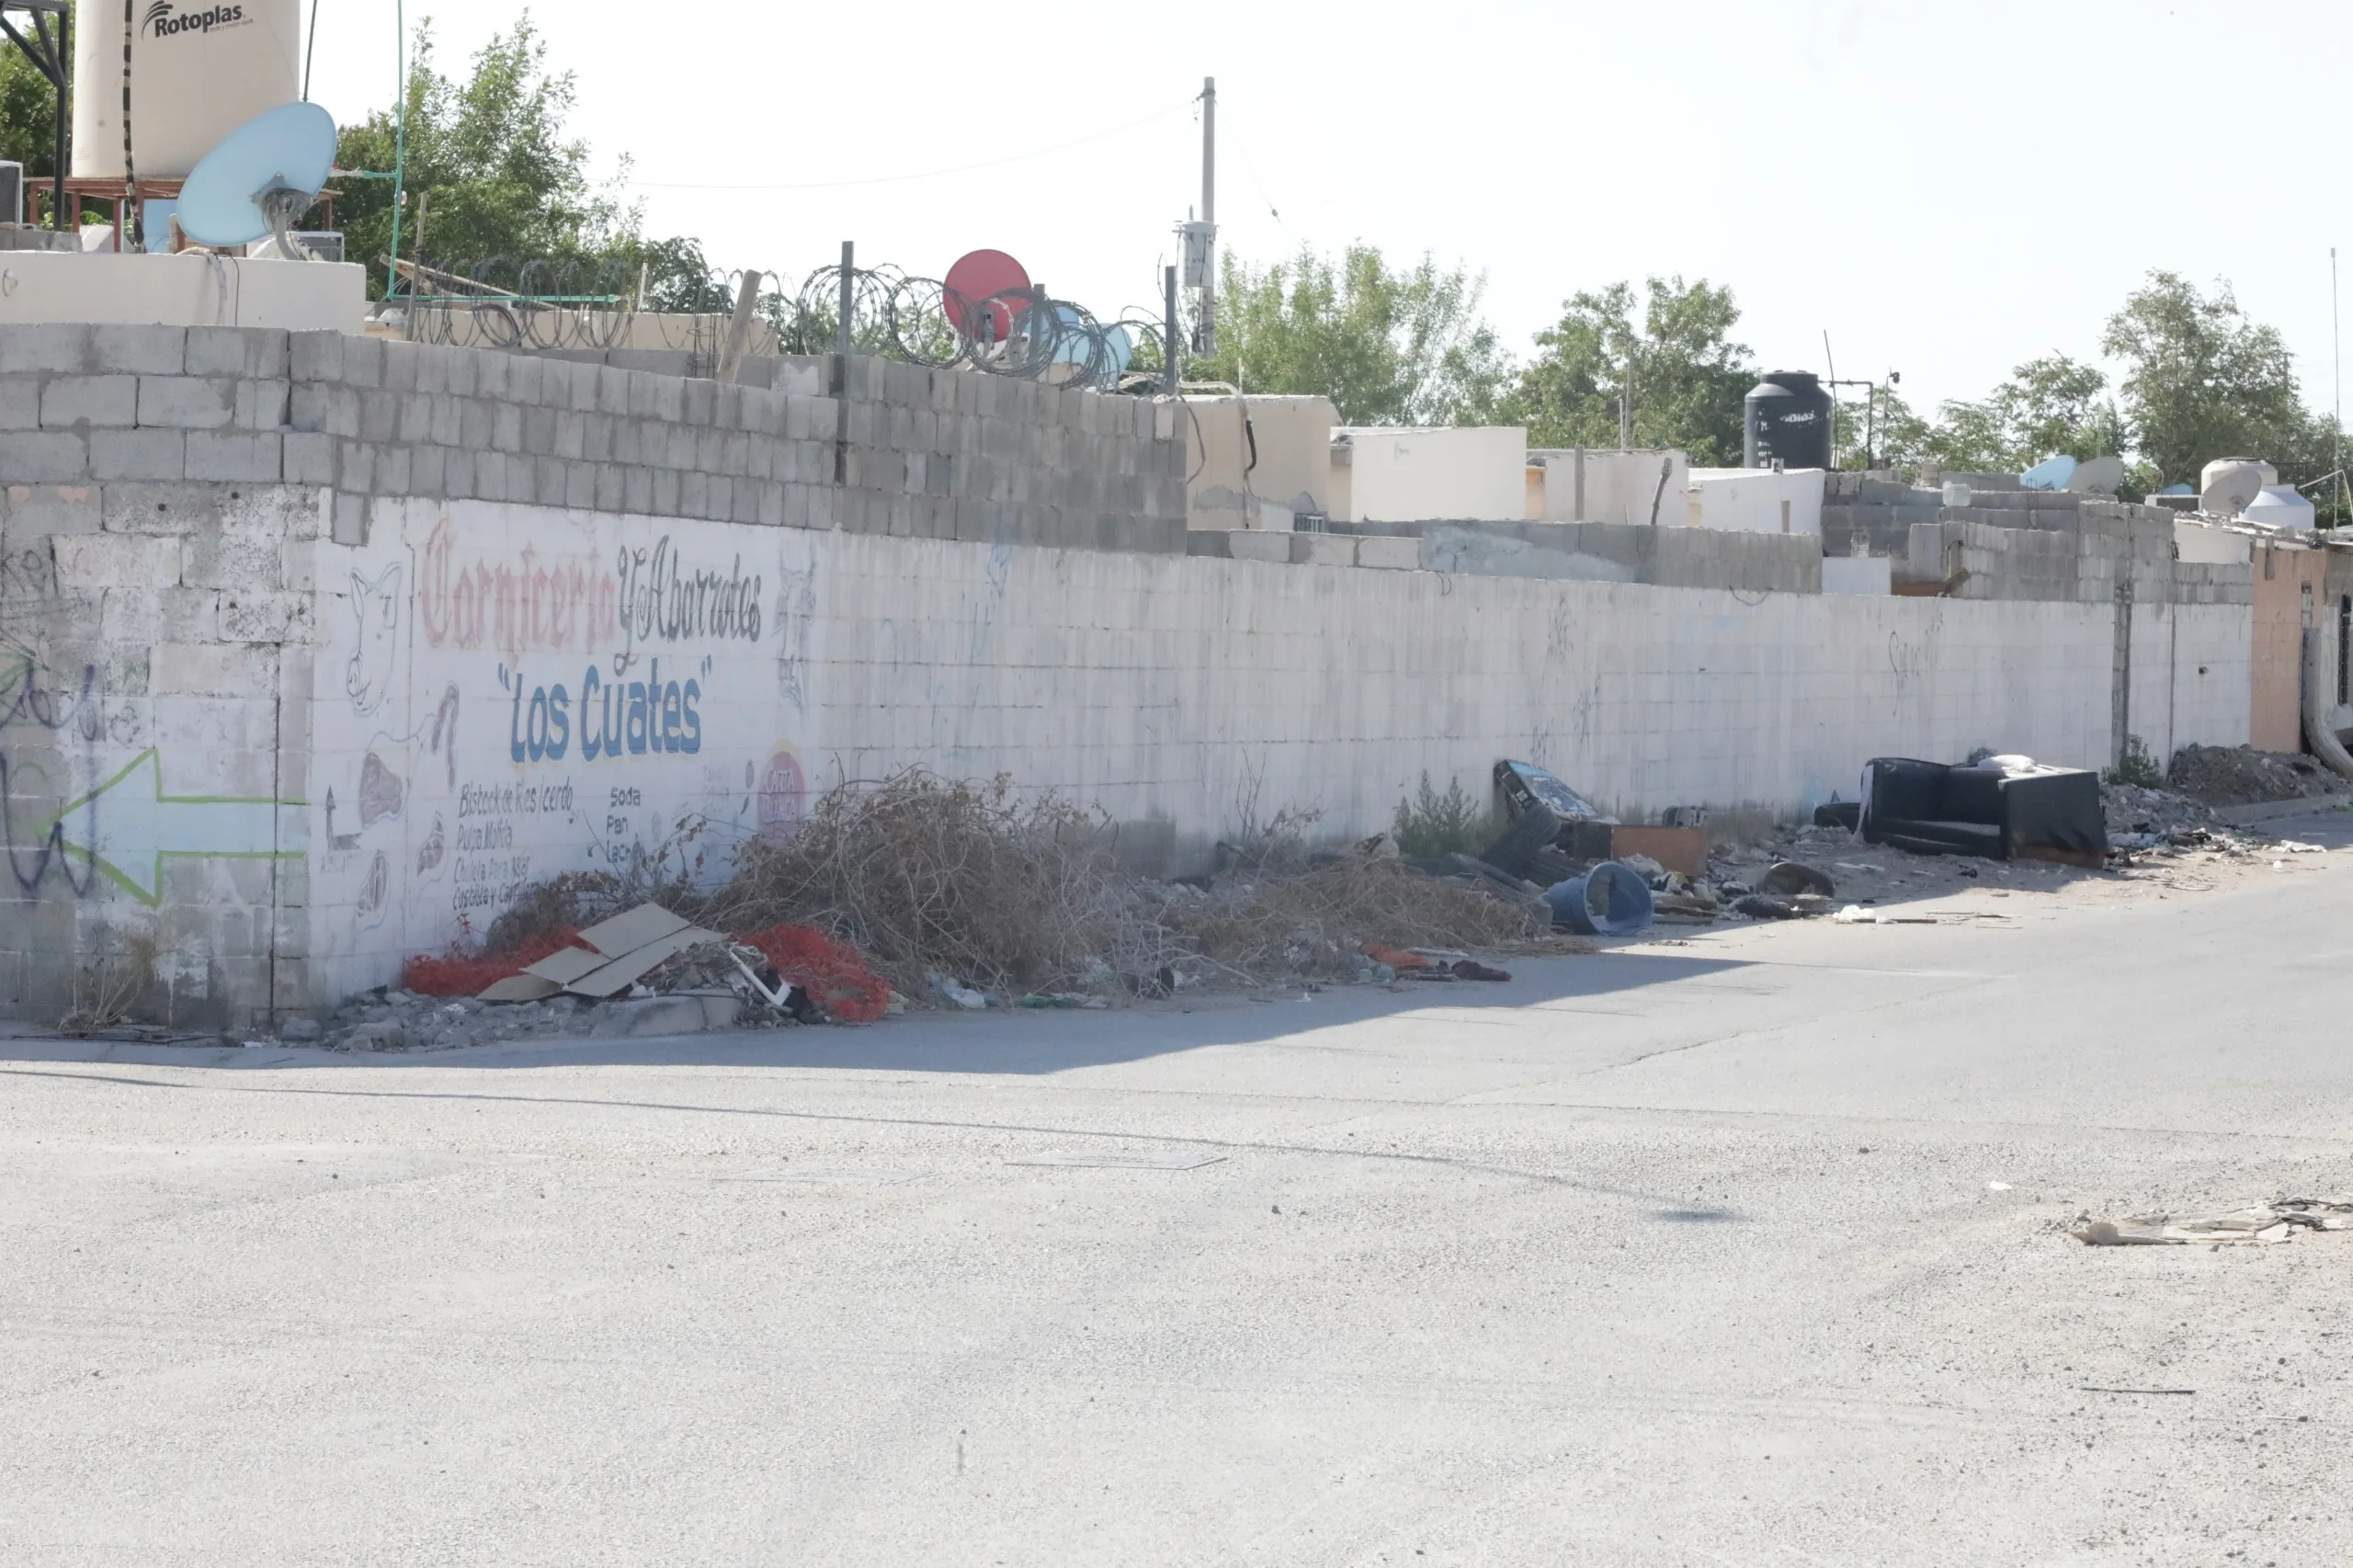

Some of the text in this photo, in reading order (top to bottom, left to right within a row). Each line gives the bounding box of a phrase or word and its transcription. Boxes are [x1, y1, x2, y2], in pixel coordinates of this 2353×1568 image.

[154, 5, 244, 38] Rotoplas
[610, 786, 641, 807] Soda
[607, 814, 628, 835] Pan
